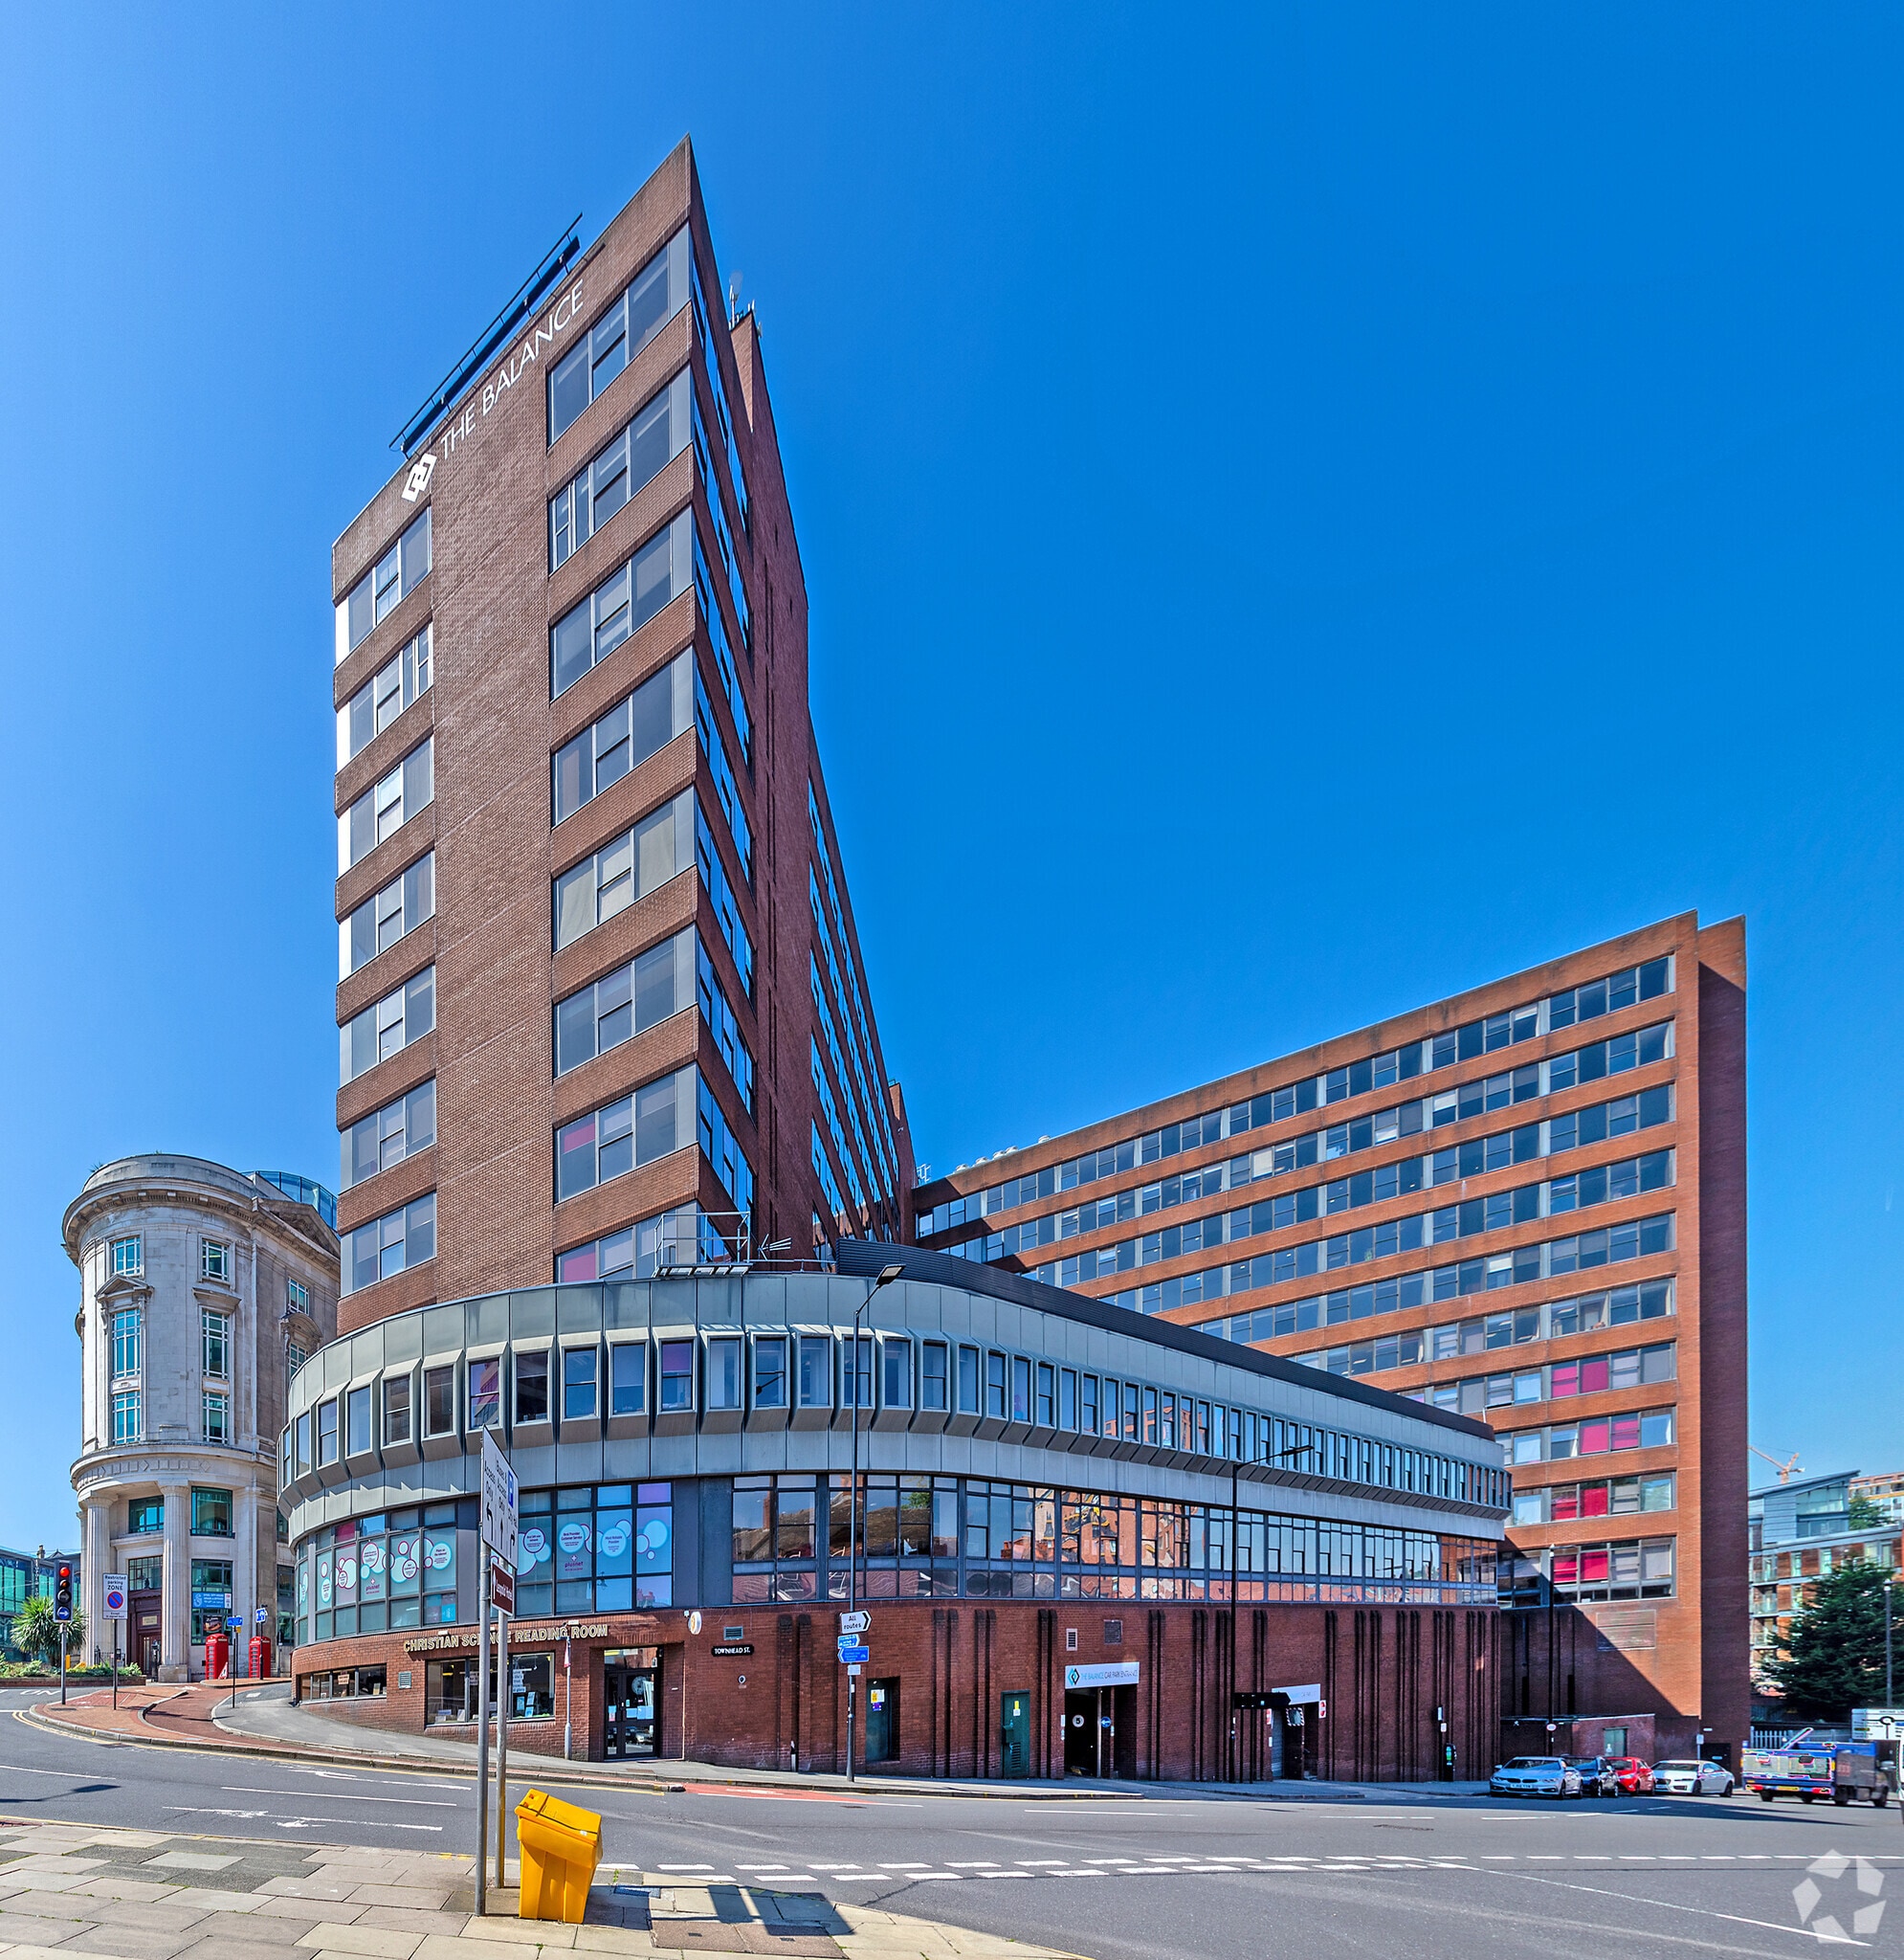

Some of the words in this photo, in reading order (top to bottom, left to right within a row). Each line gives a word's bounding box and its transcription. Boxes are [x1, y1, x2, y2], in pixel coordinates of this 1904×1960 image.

[441, 403, 476, 459] THE
[482, 278, 584, 416] BALANCE
[403, 1635, 459, 1652] CHRISTIAN
[461, 1630, 512, 1647] SCINE
[515, 1626, 568, 1642] READING
[571, 1624, 609, 1639] ROOM
